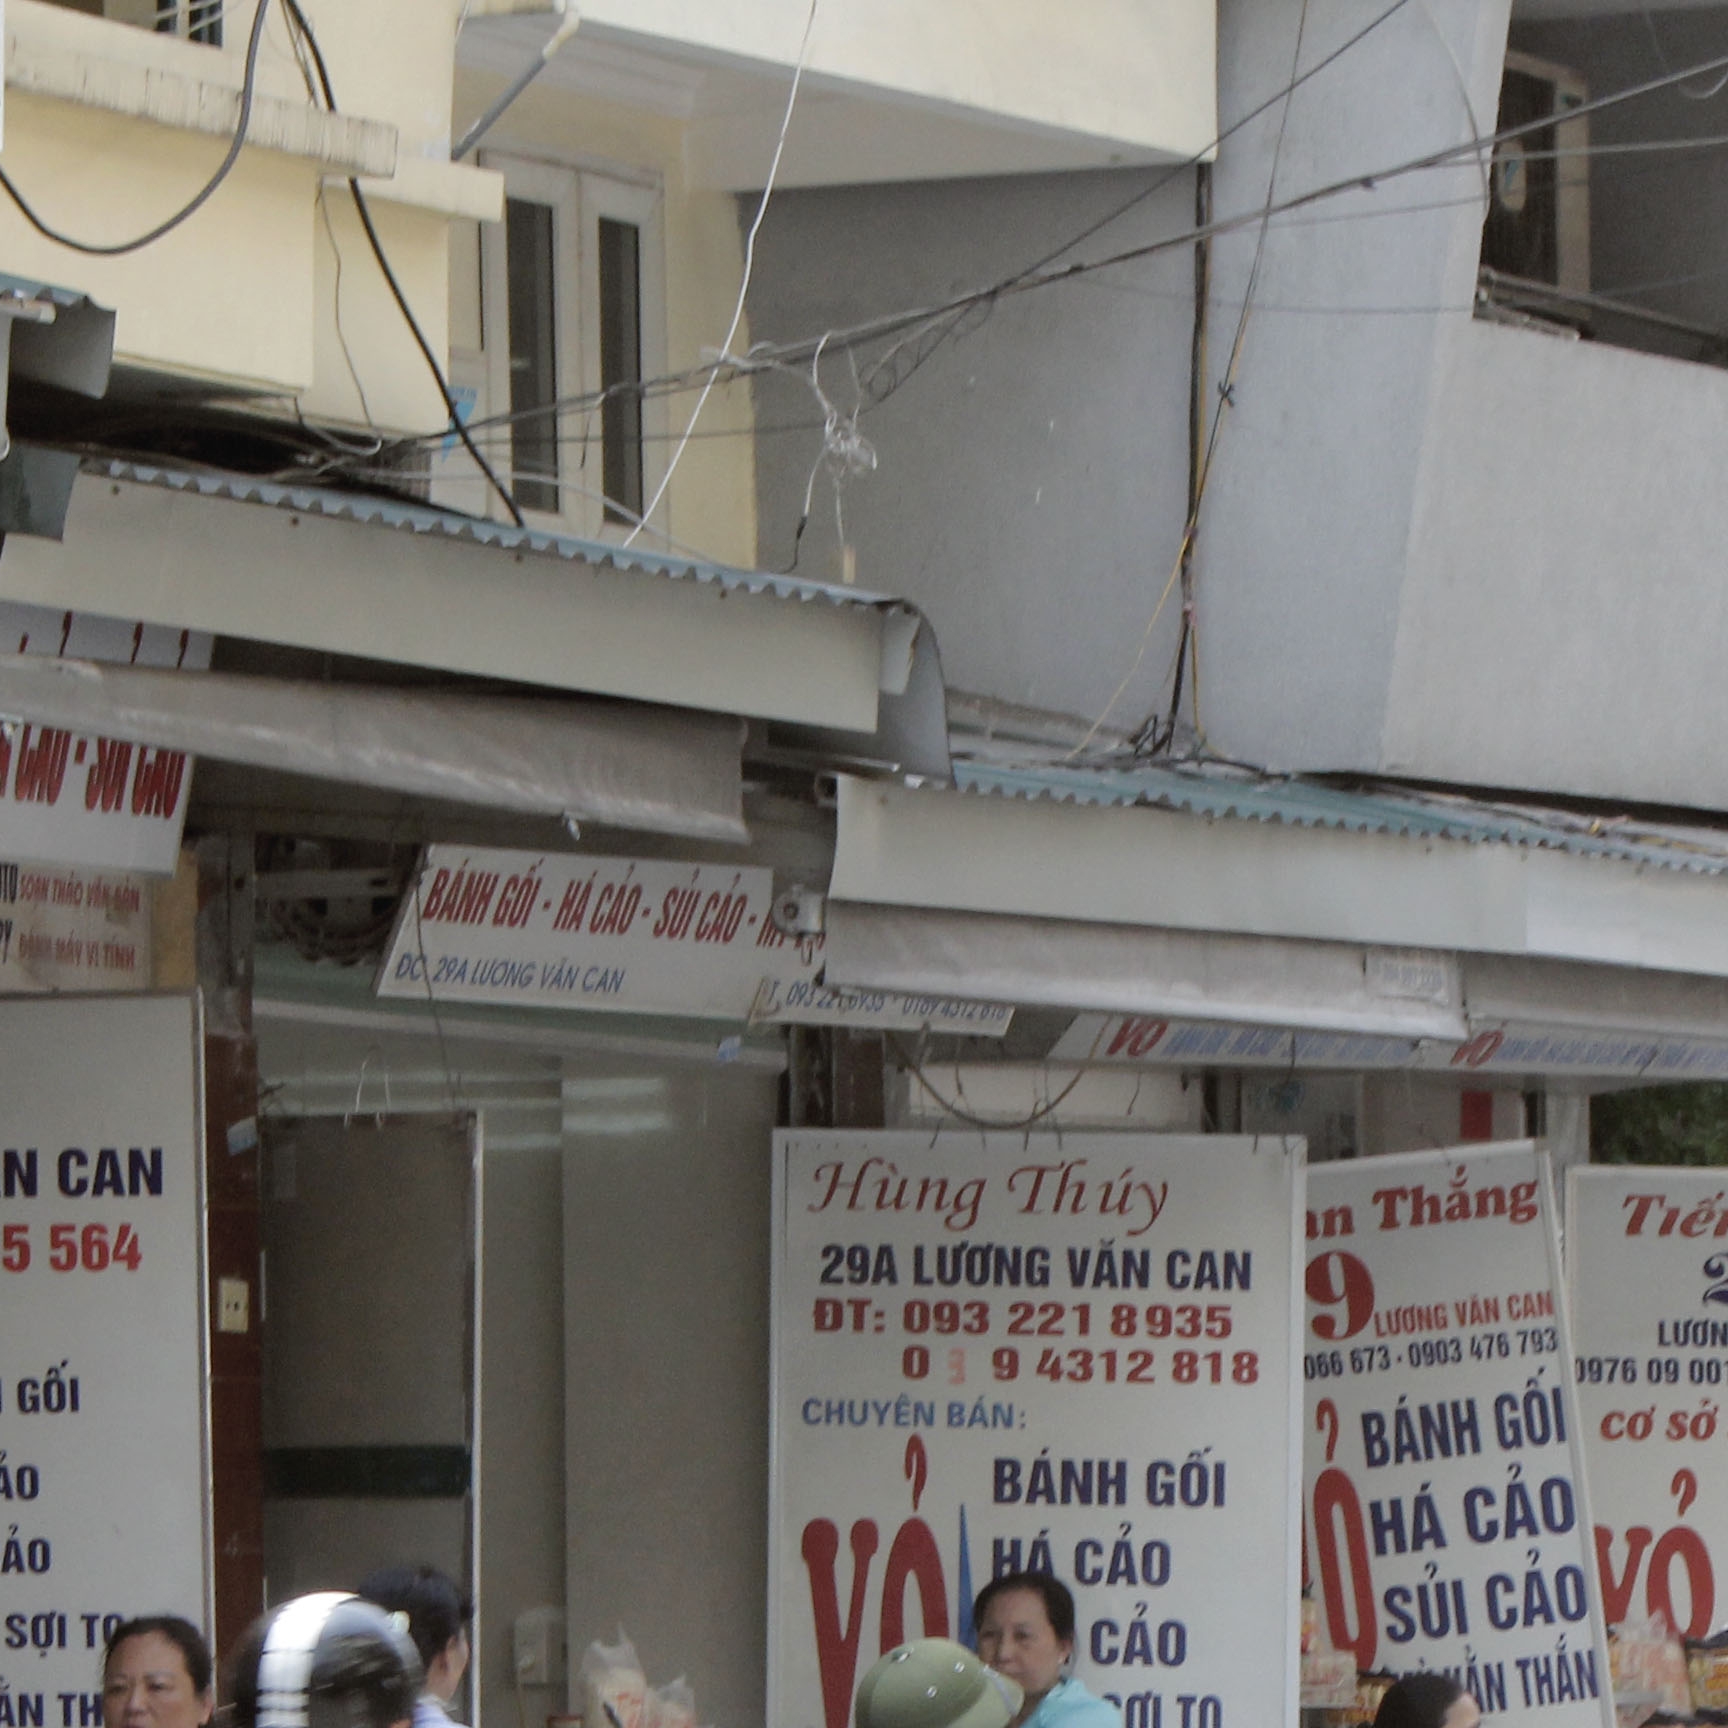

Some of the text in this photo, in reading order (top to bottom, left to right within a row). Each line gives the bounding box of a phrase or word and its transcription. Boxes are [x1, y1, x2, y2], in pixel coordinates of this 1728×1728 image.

[422, 858, 500, 927] BÁNH
[552, 870, 598, 933] HÁ
[431, 956, 628, 994] 29A CAN
[56, 1146, 165, 1199] CAN
[807, 1157, 1170, 1238] Hùng Thúy
[1371, 1164, 1539, 1232] Thắng
[48, 1222, 142, 1272] 564
[819, 1238, 1253, 1292] 29A LƯƠNG VĂN CAN
[813, 1297, 886, 1334] ĐT:
[902, 1299, 990, 1335] 093
[1007, 1302, 1091, 1337] 221
[1507, 1289, 1554, 1321] CAN
[1035, 1348, 1260, 1385] 4312 818
[1350, 1345, 1392, 1375] 673
[1407, 1338, 1462, 1369] 0903
[1470, 1331, 1510, 1361] 476
[1516, 1325, 1559, 1355] 793
[1646, 1356, 1680, 1386] 09
[16, 1360, 82, 1415] GỐI
[801, 1393, 936, 1428] CHUYÊN
[1360, 1366, 1567, 1469] BÁNH GỐI
[1599, 1403, 1655, 1442] CƠ
[993, 1446, 1227, 1509] BÁNH GỐI
[1369, 1461, 1576, 1557] HÁ CẢO
[991, 1520, 1172, 1588] HÁ CẢO
[1383, 1547, 1588, 1643] SỦI CẢO
[3, 1611, 67, 1660] SỢI
[1089, 1601, 1188, 1668] CẢO
